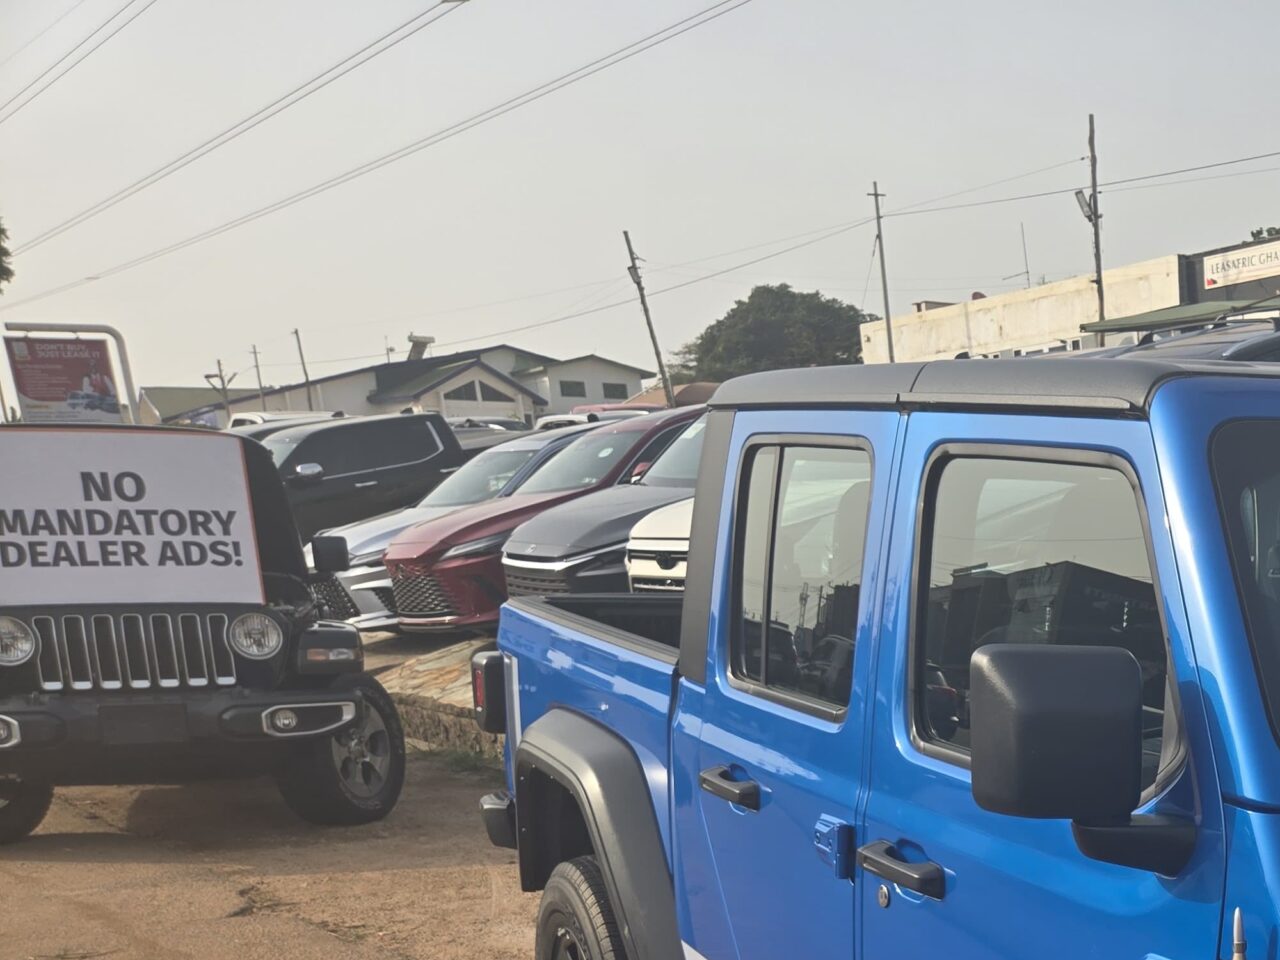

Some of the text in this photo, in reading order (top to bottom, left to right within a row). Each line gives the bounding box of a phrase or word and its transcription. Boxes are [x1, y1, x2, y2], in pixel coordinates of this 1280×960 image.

[1211, 255, 1256, 274] LEASAFRIC
[80, 471, 147, 503] NO
[0, 508, 237, 536] MANDATORY
[0, 540, 244, 567] DEALER ADS!
